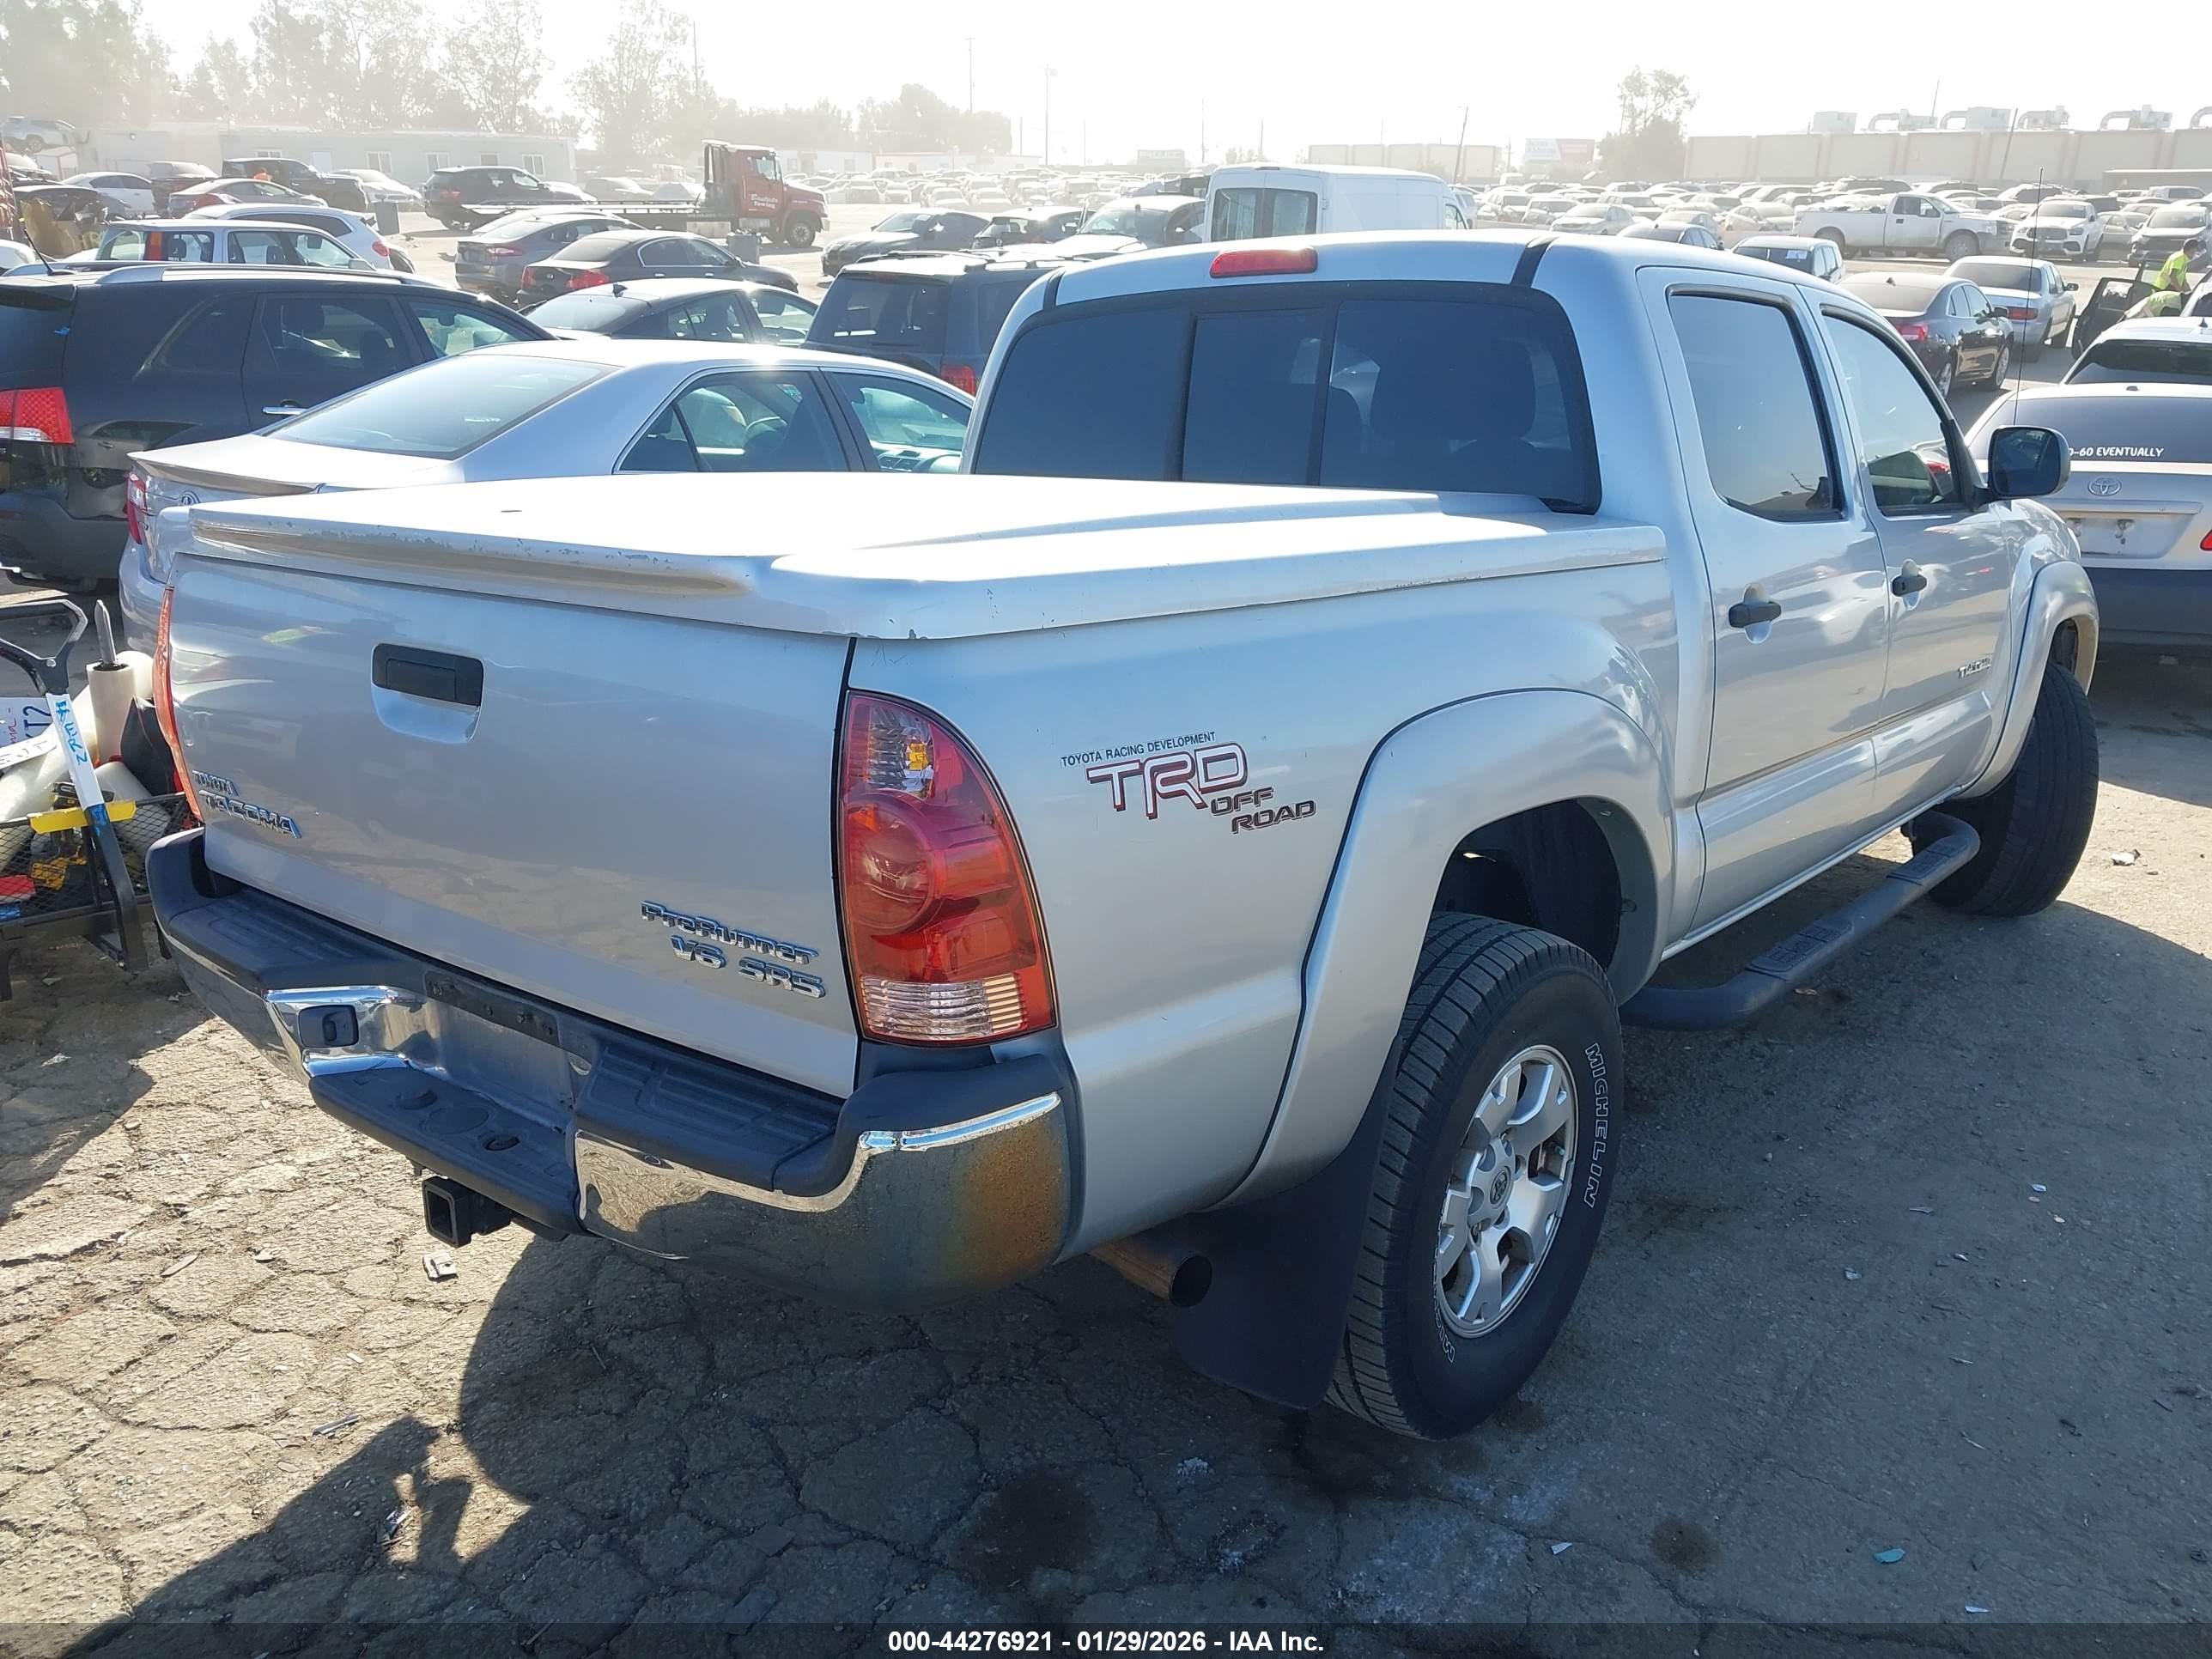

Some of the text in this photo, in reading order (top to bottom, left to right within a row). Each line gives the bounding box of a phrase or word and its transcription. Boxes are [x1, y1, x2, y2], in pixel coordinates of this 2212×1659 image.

[2096, 447, 2164, 457] EVENTUALLY
[1061, 731, 1217, 768] TOYOTA RACING DEVELOPMENT
[191, 769, 239, 798] TOYOTA
[1085, 743, 1249, 819] TRD
[1210, 786, 1275, 816] OFF
[198, 789, 302, 839] TACOMA
[1231, 799, 1316, 834] ROAD
[641, 900, 819, 966] PreRunner
[670, 934, 826, 999] V6 SR5
[1583, 1042, 1608, 1208] MICHELIN
